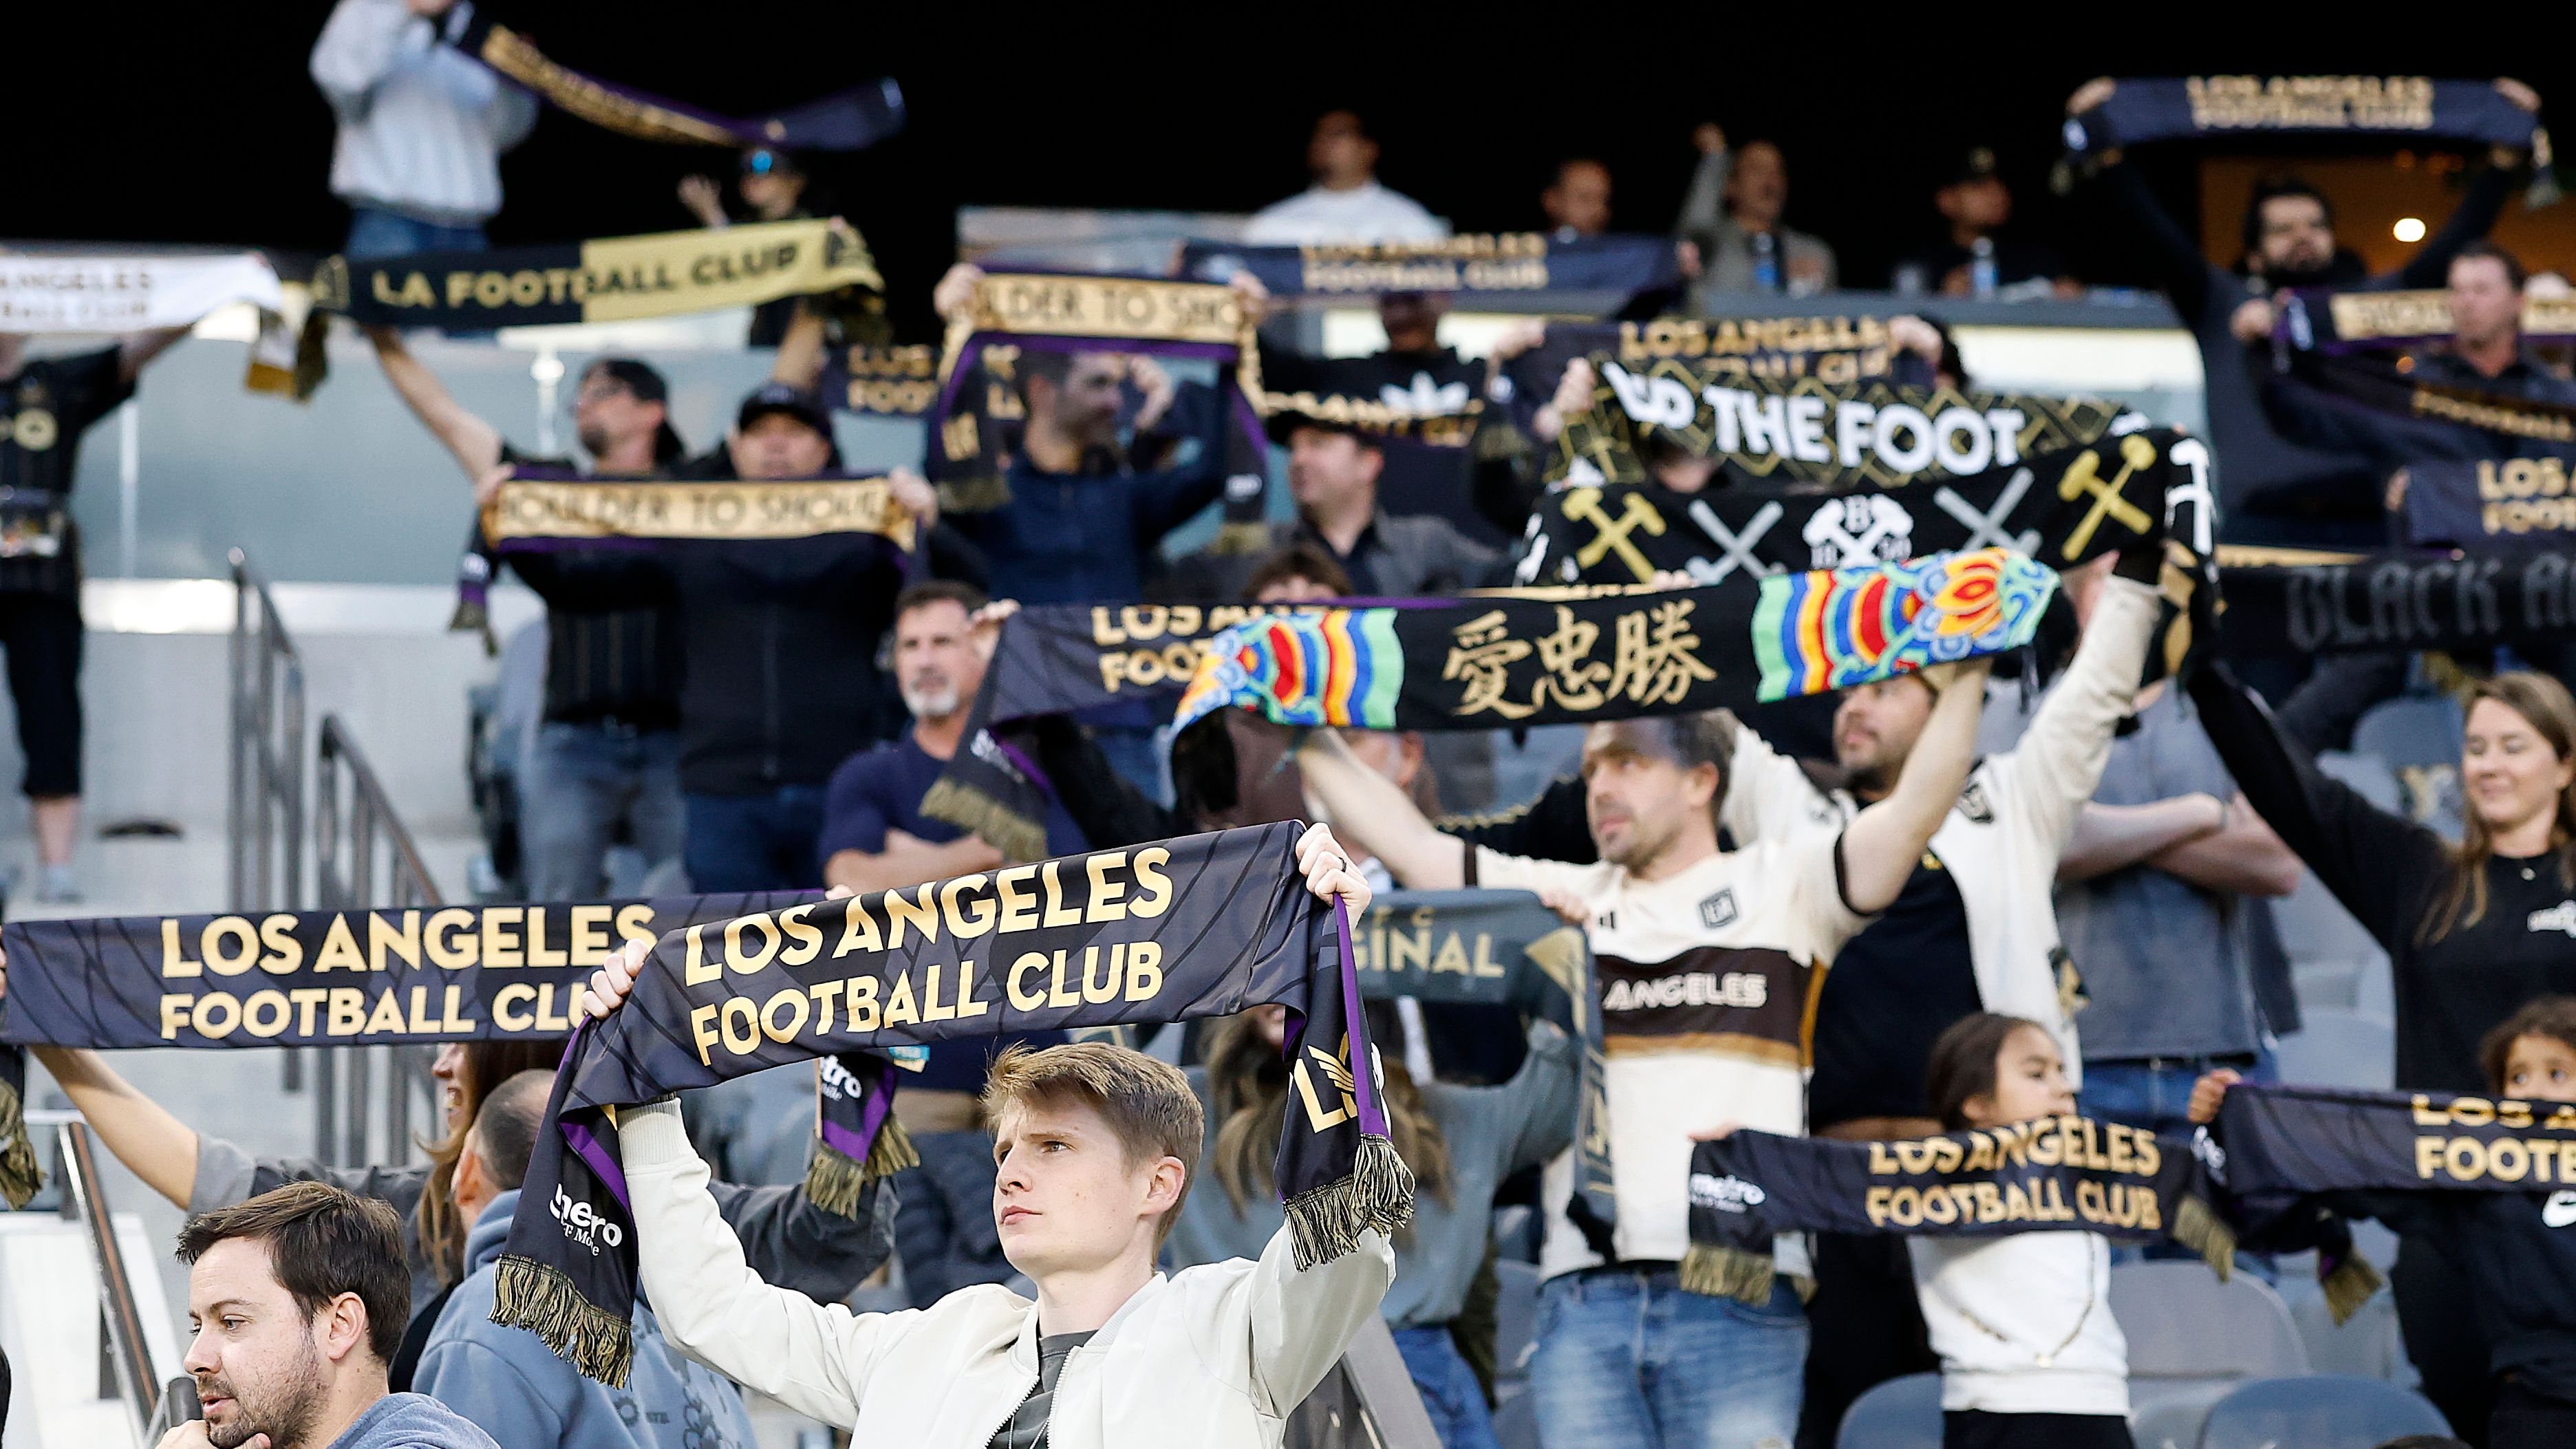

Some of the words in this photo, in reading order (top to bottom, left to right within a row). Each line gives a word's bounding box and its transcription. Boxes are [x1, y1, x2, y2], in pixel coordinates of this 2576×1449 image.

[372, 270, 438, 308] LA
[446, 256, 678, 308] FOOTBALL
[1620, 319, 1708, 361] LOS
[1702, 383, 1832, 464] THE
[1835, 401, 2026, 476] FOOT
[2478, 457, 2568, 502] LOS
[692, 489, 748, 531] TO
[1091, 605, 1203, 645] LOS
[2286, 560, 2500, 652] BLACK
[1442, 597, 1719, 720] 愛忠勝
[160, 914, 303, 980] LOS
[314, 903, 658, 972] ANGELES
[684, 904, 824, 986] LOS
[831, 846, 1174, 959] ANGELES
[160, 985, 477, 1041] FOOTBALL
[689, 958, 989, 1067] FOOTBALL
[1006, 940, 1164, 1013] CLUB
[1602, 971, 1768, 1011] ANGELES
[2410, 1093, 2535, 1129] LOS
[1869, 1137, 1964, 1175] LOS
[1964, 1113, 2161, 1177] ANGELES
[1865, 1177, 2075, 1227] FOOTBALL
[2075, 1178, 2162, 1230] CLUB
